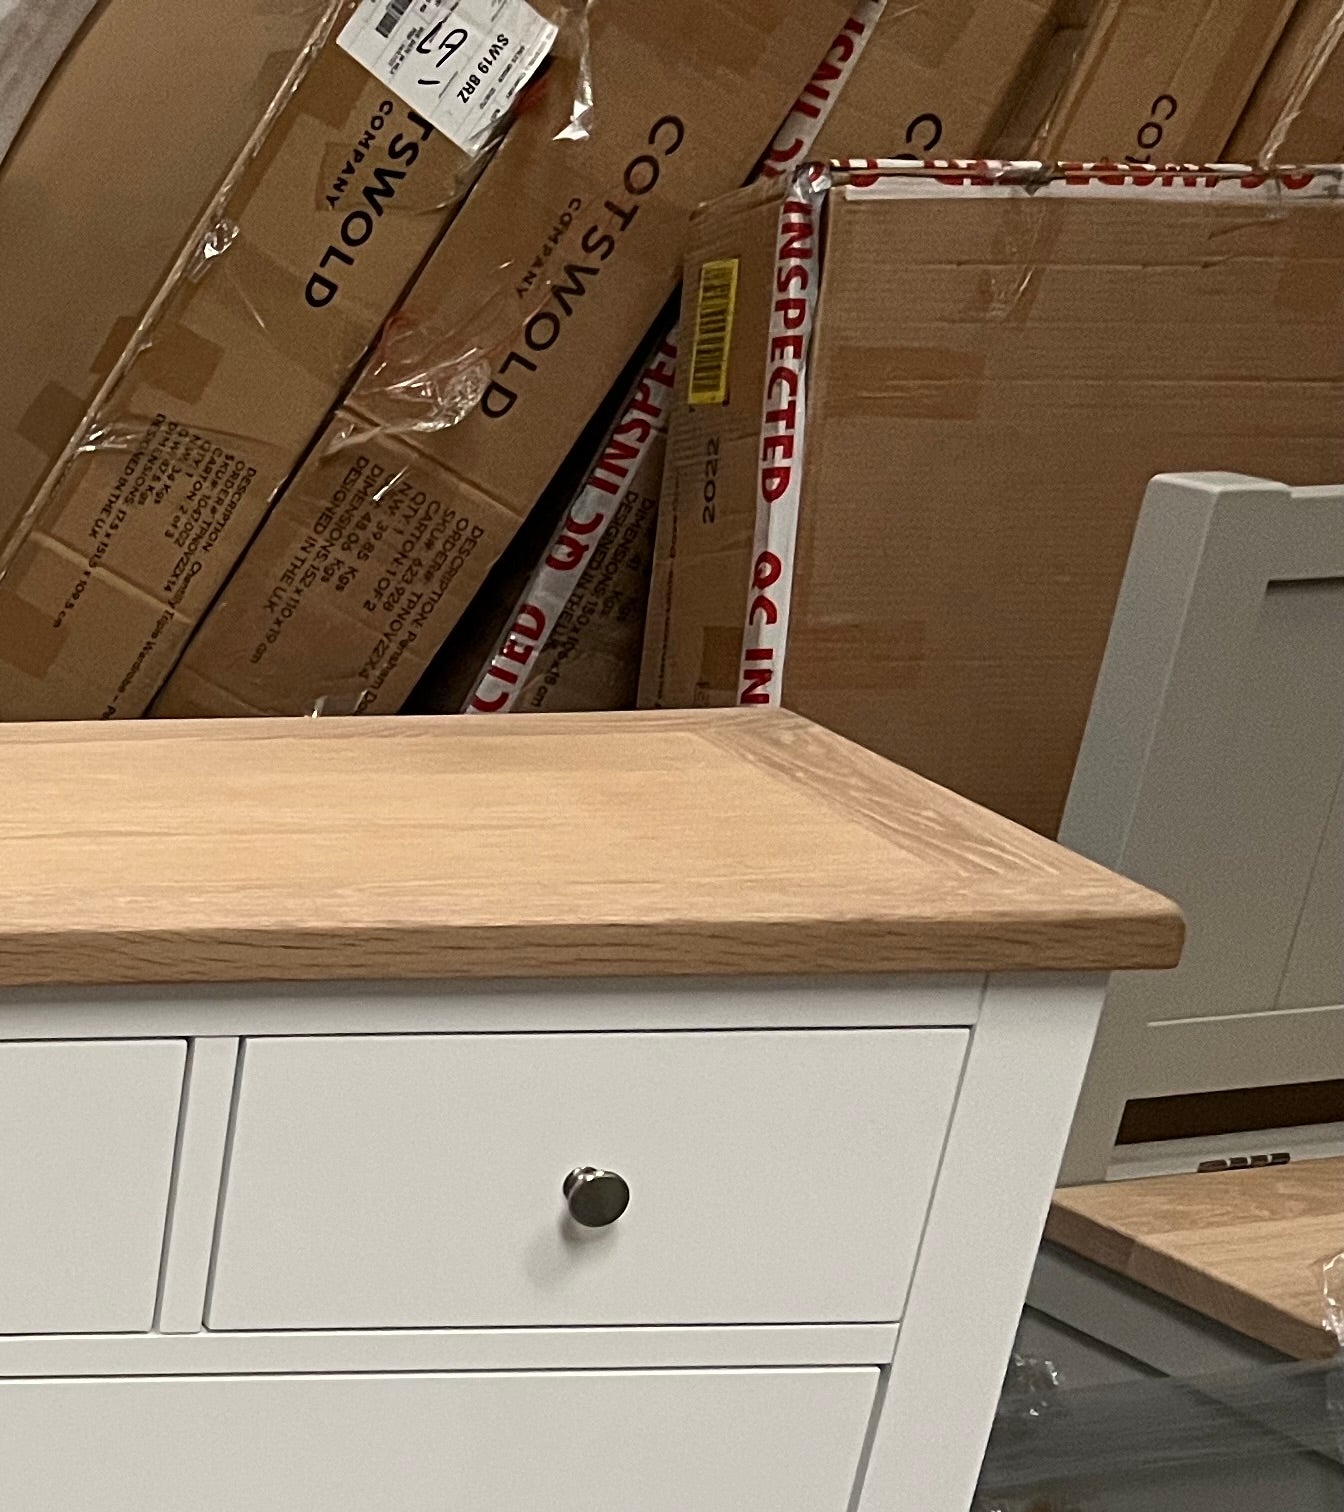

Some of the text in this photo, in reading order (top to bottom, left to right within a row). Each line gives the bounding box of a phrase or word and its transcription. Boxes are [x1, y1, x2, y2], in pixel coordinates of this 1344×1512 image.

[476, 33, 510, 75] SW19
[455, 74, 482, 104] 8RZ
[323, 99, 395, 211] COMPANY
[304, 110, 435, 308] TSWOLD
[479, 113, 686, 421] COTSWOLD
[514, 196, 582, 300] COMPANY
[759, 203, 817, 505] INSPECTED
[113, 476, 129, 492] IN
[311, 454, 370, 537] DESIGNED
[699, 435, 723, 524] 2022
[98, 490, 121, 518] THE
[298, 534, 318, 555] IN
[585, 488, 640, 571] DESIGNED
[279, 553, 306, 587] THE
[316, 554, 344, 586] Kgs
[331, 562, 359, 595] Kgs
[369, 575, 392, 602] OF
[380, 554, 424, 614] 623.928
[576, 570, 595, 590] IN
[749, 550, 783, 628] QC
[361, 598, 377, 613] 2
[557, 590, 584, 624] THE
